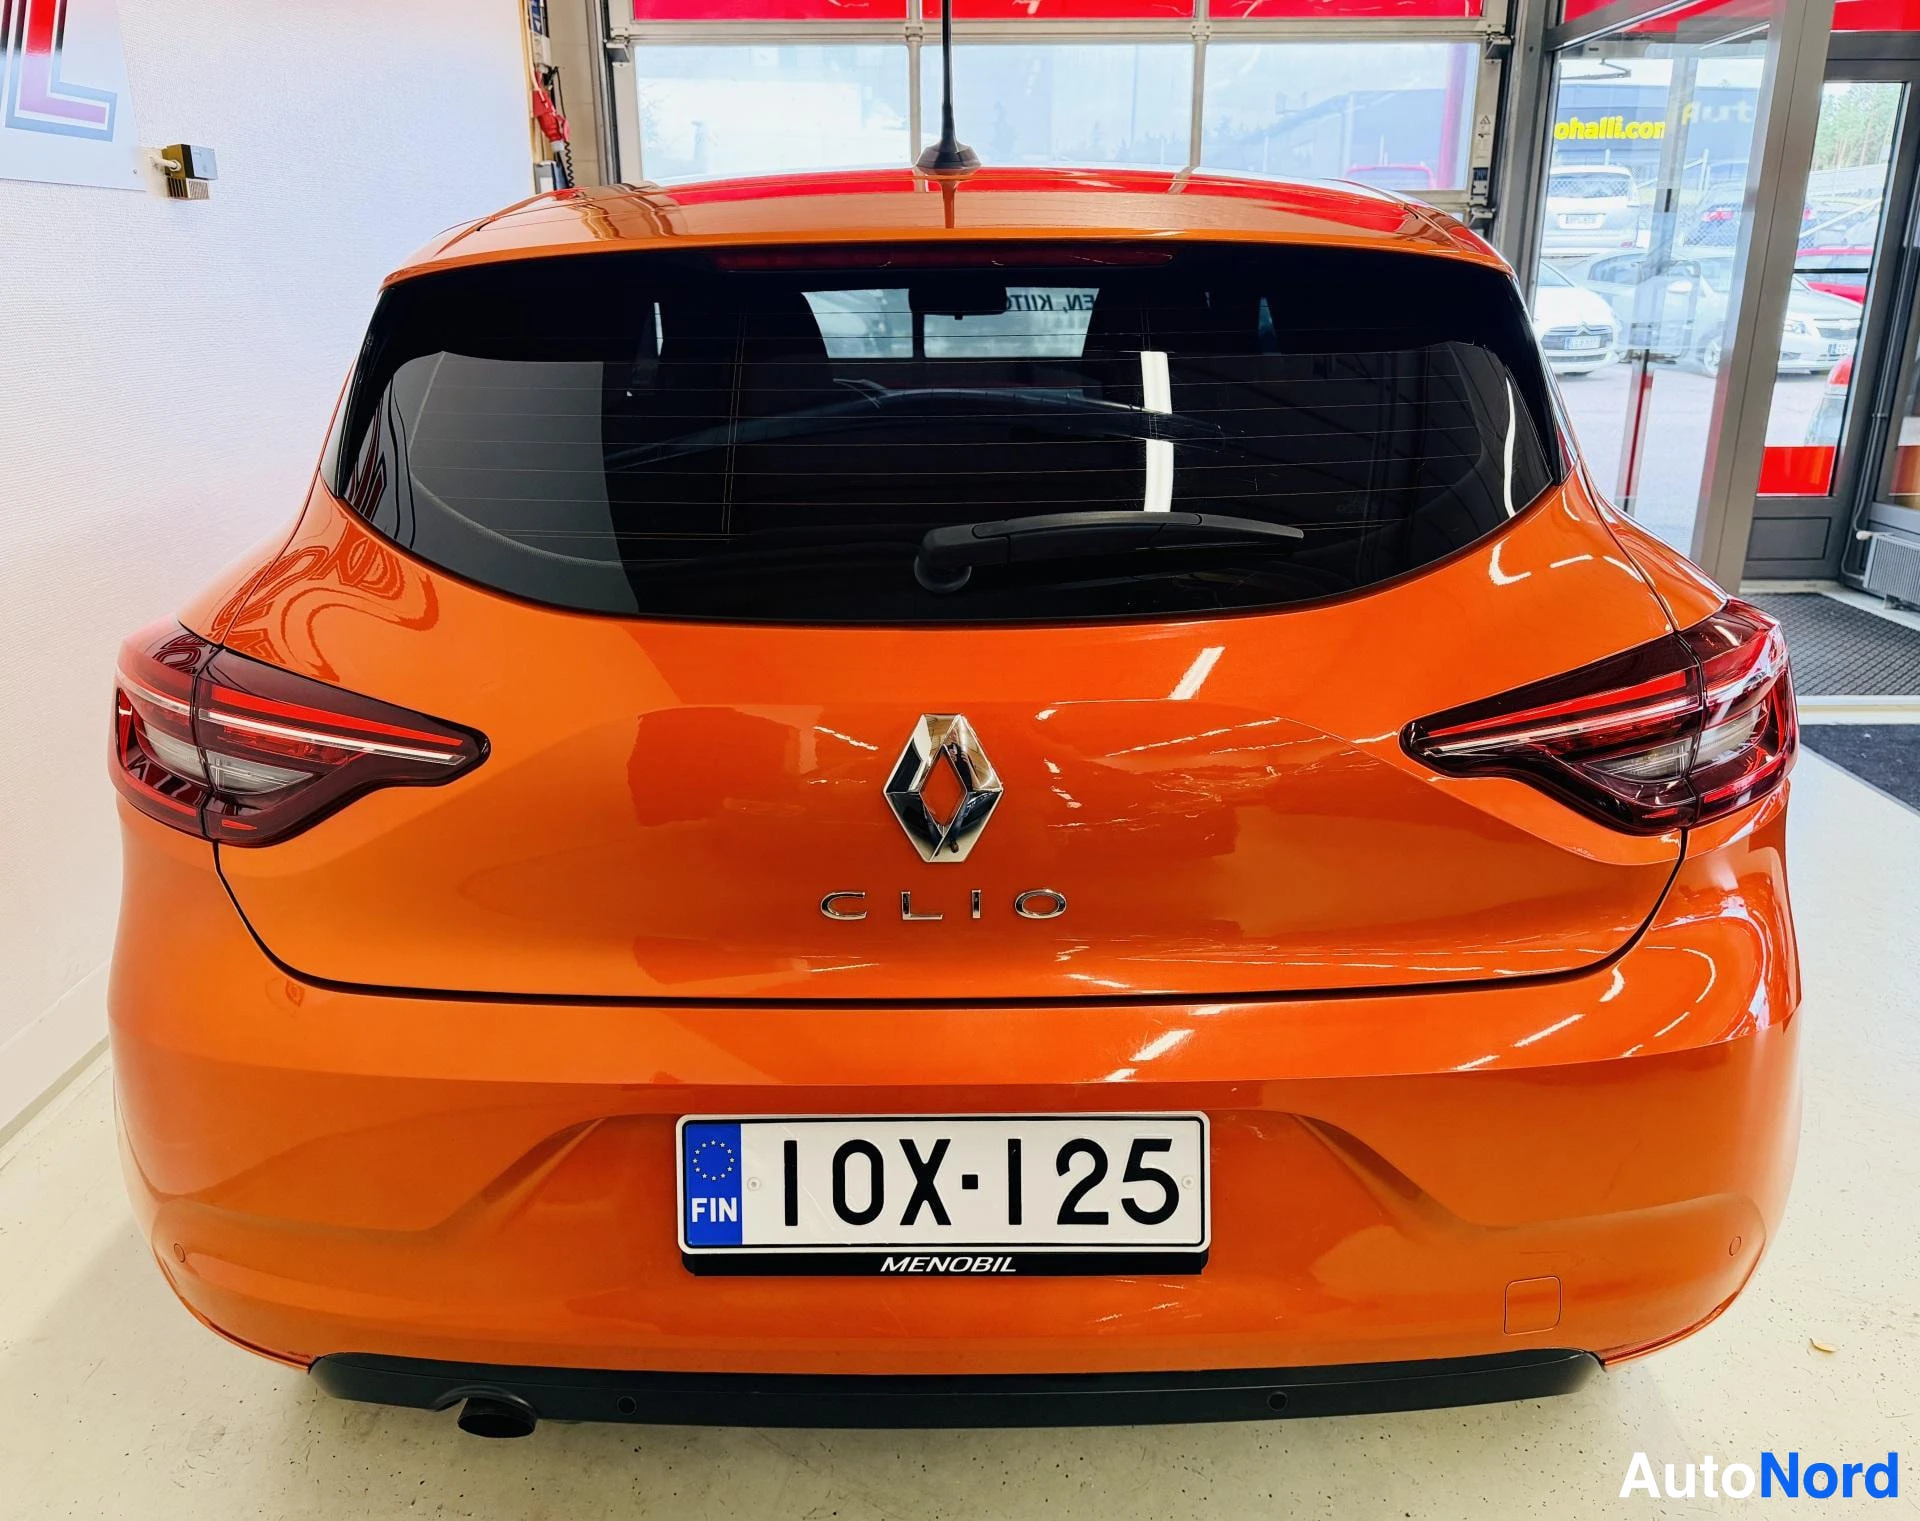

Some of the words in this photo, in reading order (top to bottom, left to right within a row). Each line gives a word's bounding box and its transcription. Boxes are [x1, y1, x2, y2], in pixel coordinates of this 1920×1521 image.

[820, 888, 1068, 921] CLIO
[691, 1198, 738, 1222] FIN
[880, 1256, 1017, 1273] MENOBIL
